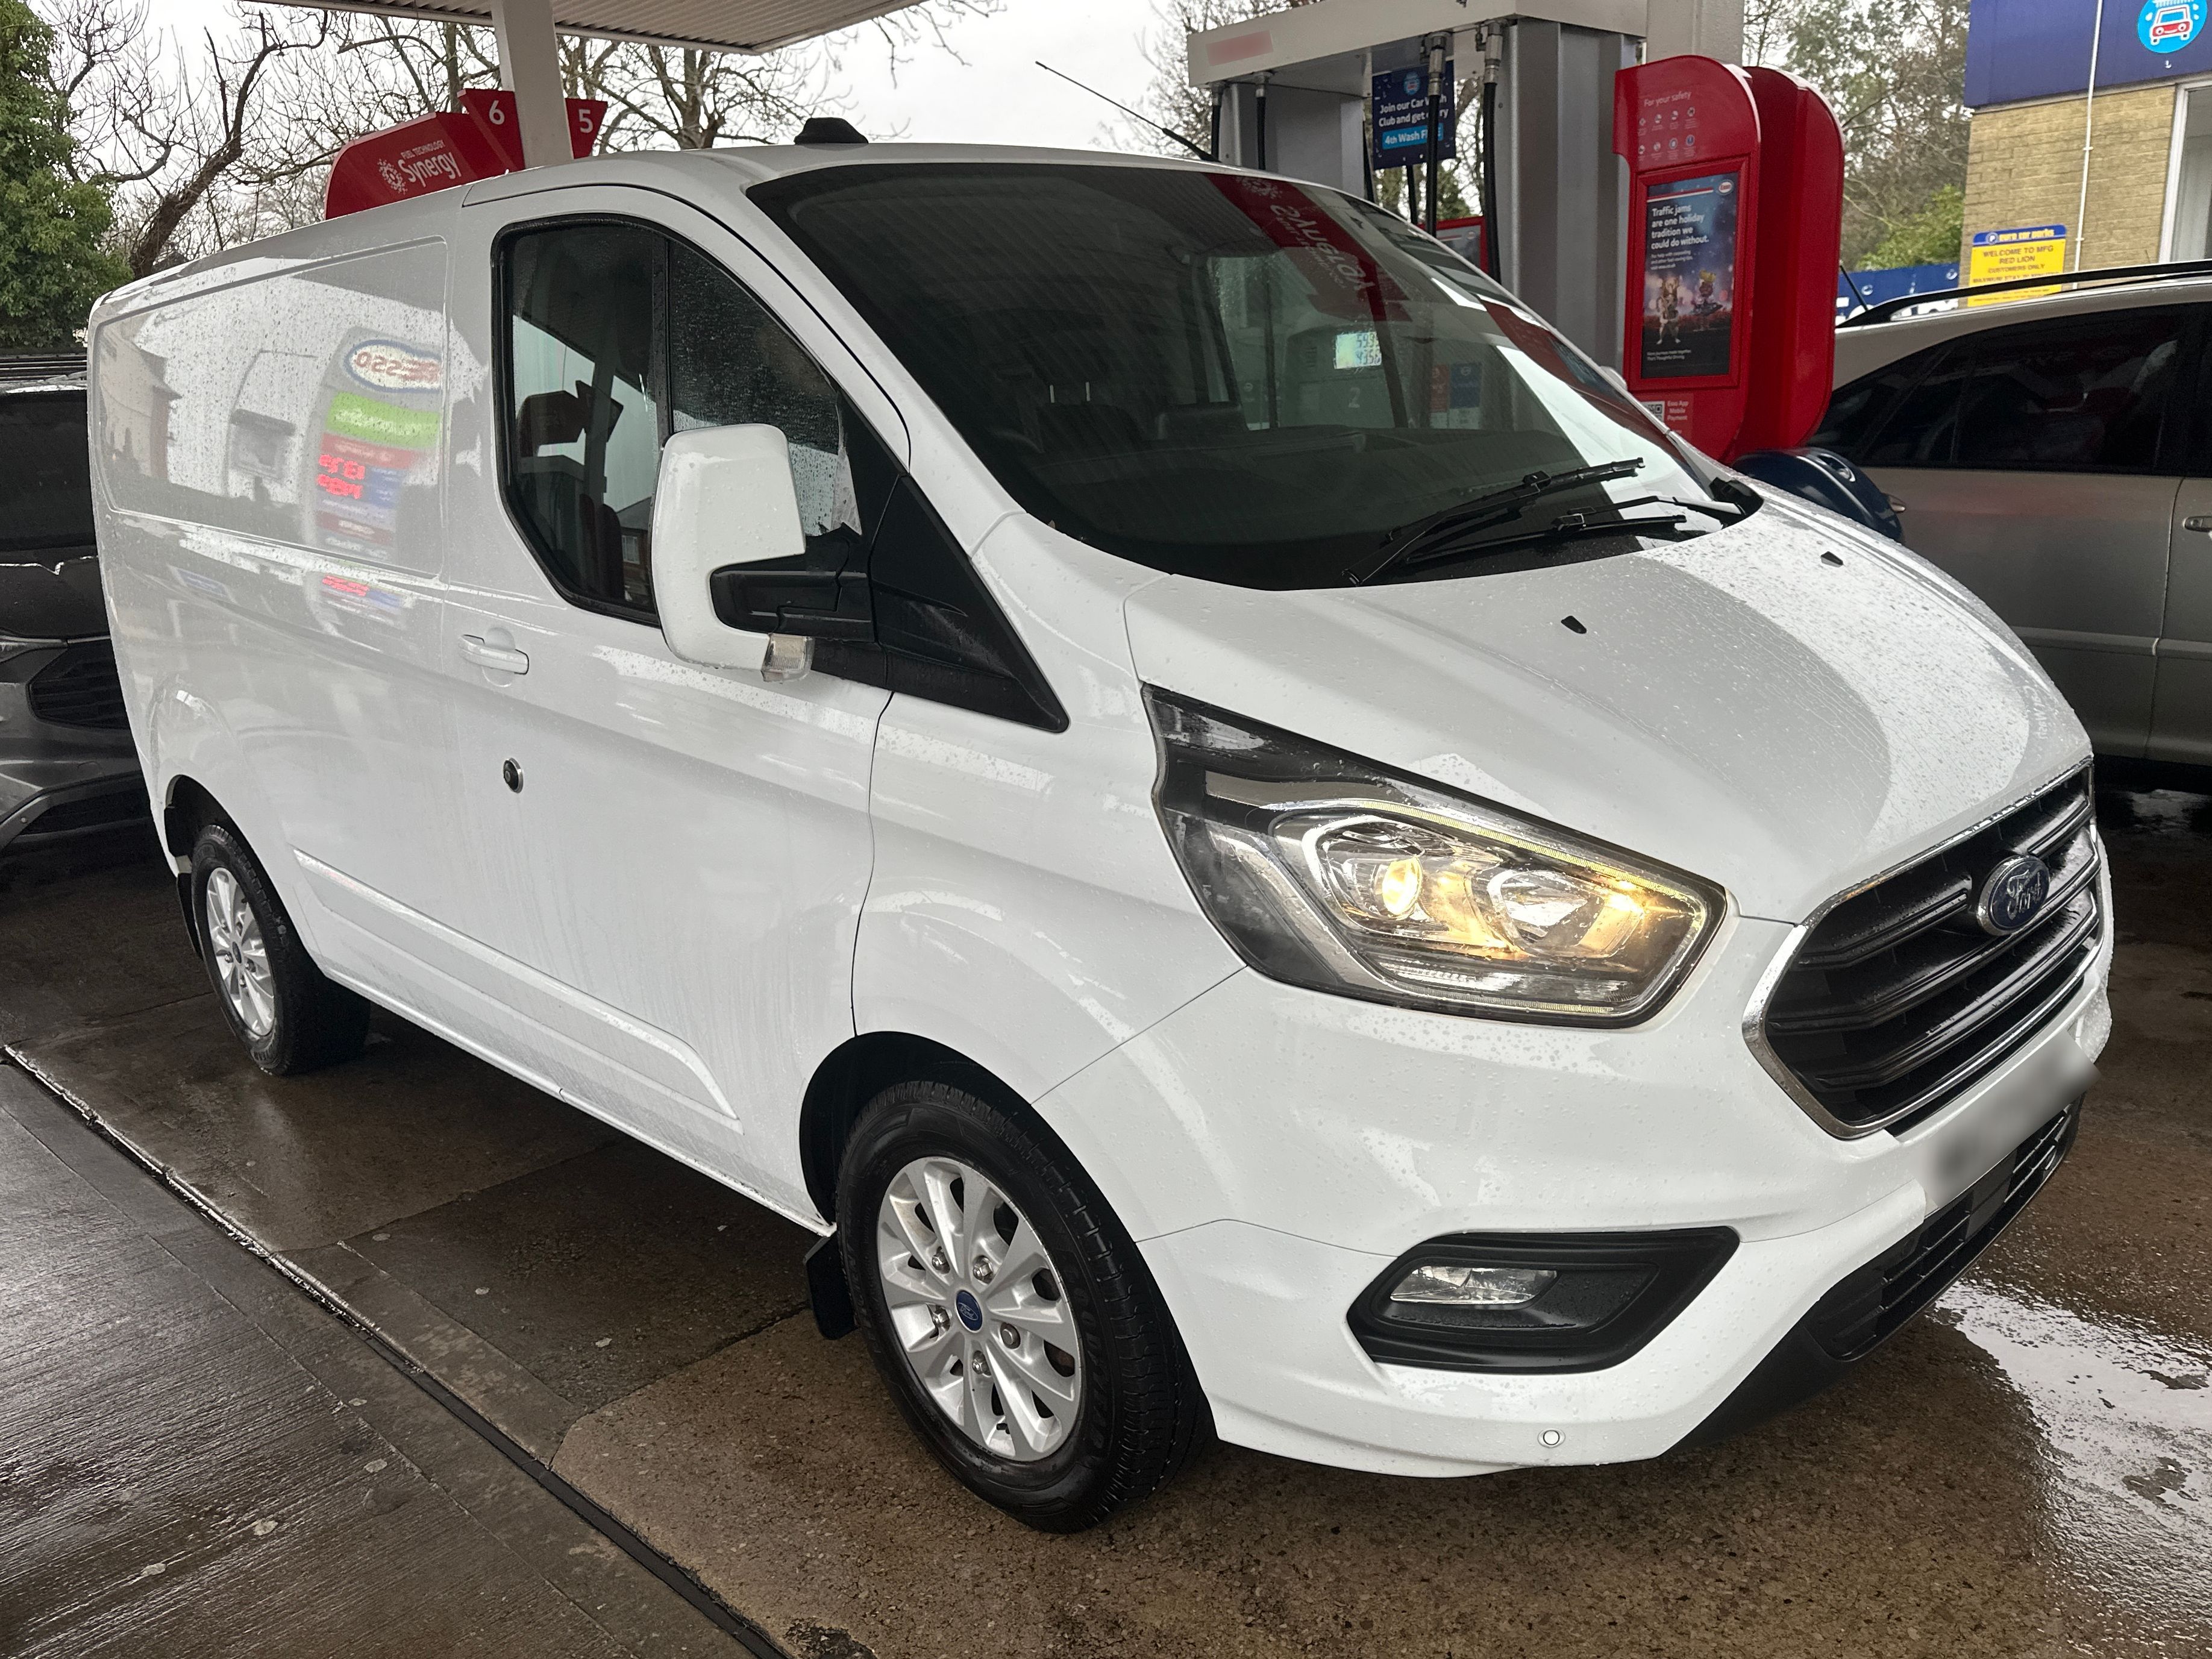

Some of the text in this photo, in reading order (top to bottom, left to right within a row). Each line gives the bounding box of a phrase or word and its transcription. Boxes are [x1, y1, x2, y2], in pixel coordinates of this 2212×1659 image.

[1380, 103, 1396, 114] Join
[1397, 101, 1410, 111] our
[1411, 98, 1424, 108] Car
[1644, 91, 1693, 107] For your safety
[489, 100, 505, 125] 6
[1379, 116, 1396, 127] Club
[1396, 113, 1411, 124] and
[1411, 112, 1426, 124] get
[578, 109, 594, 133] 5
[1385, 135, 1397, 144] 4th
[1398, 131, 1420, 142] Wash
[398, 152, 462, 188] Synergy
[1652, 205, 1692, 217] Traffic jams
[1652, 213, 1705, 228] are one holiday
[1651, 227, 1681, 239] tradition
[1651, 234, 1710, 249] could do without.
[1984, 248, 2023, 257] WELCOME
[1348, 387, 1361, 408] 2
[2006, 867, 2043, 920] Ford
